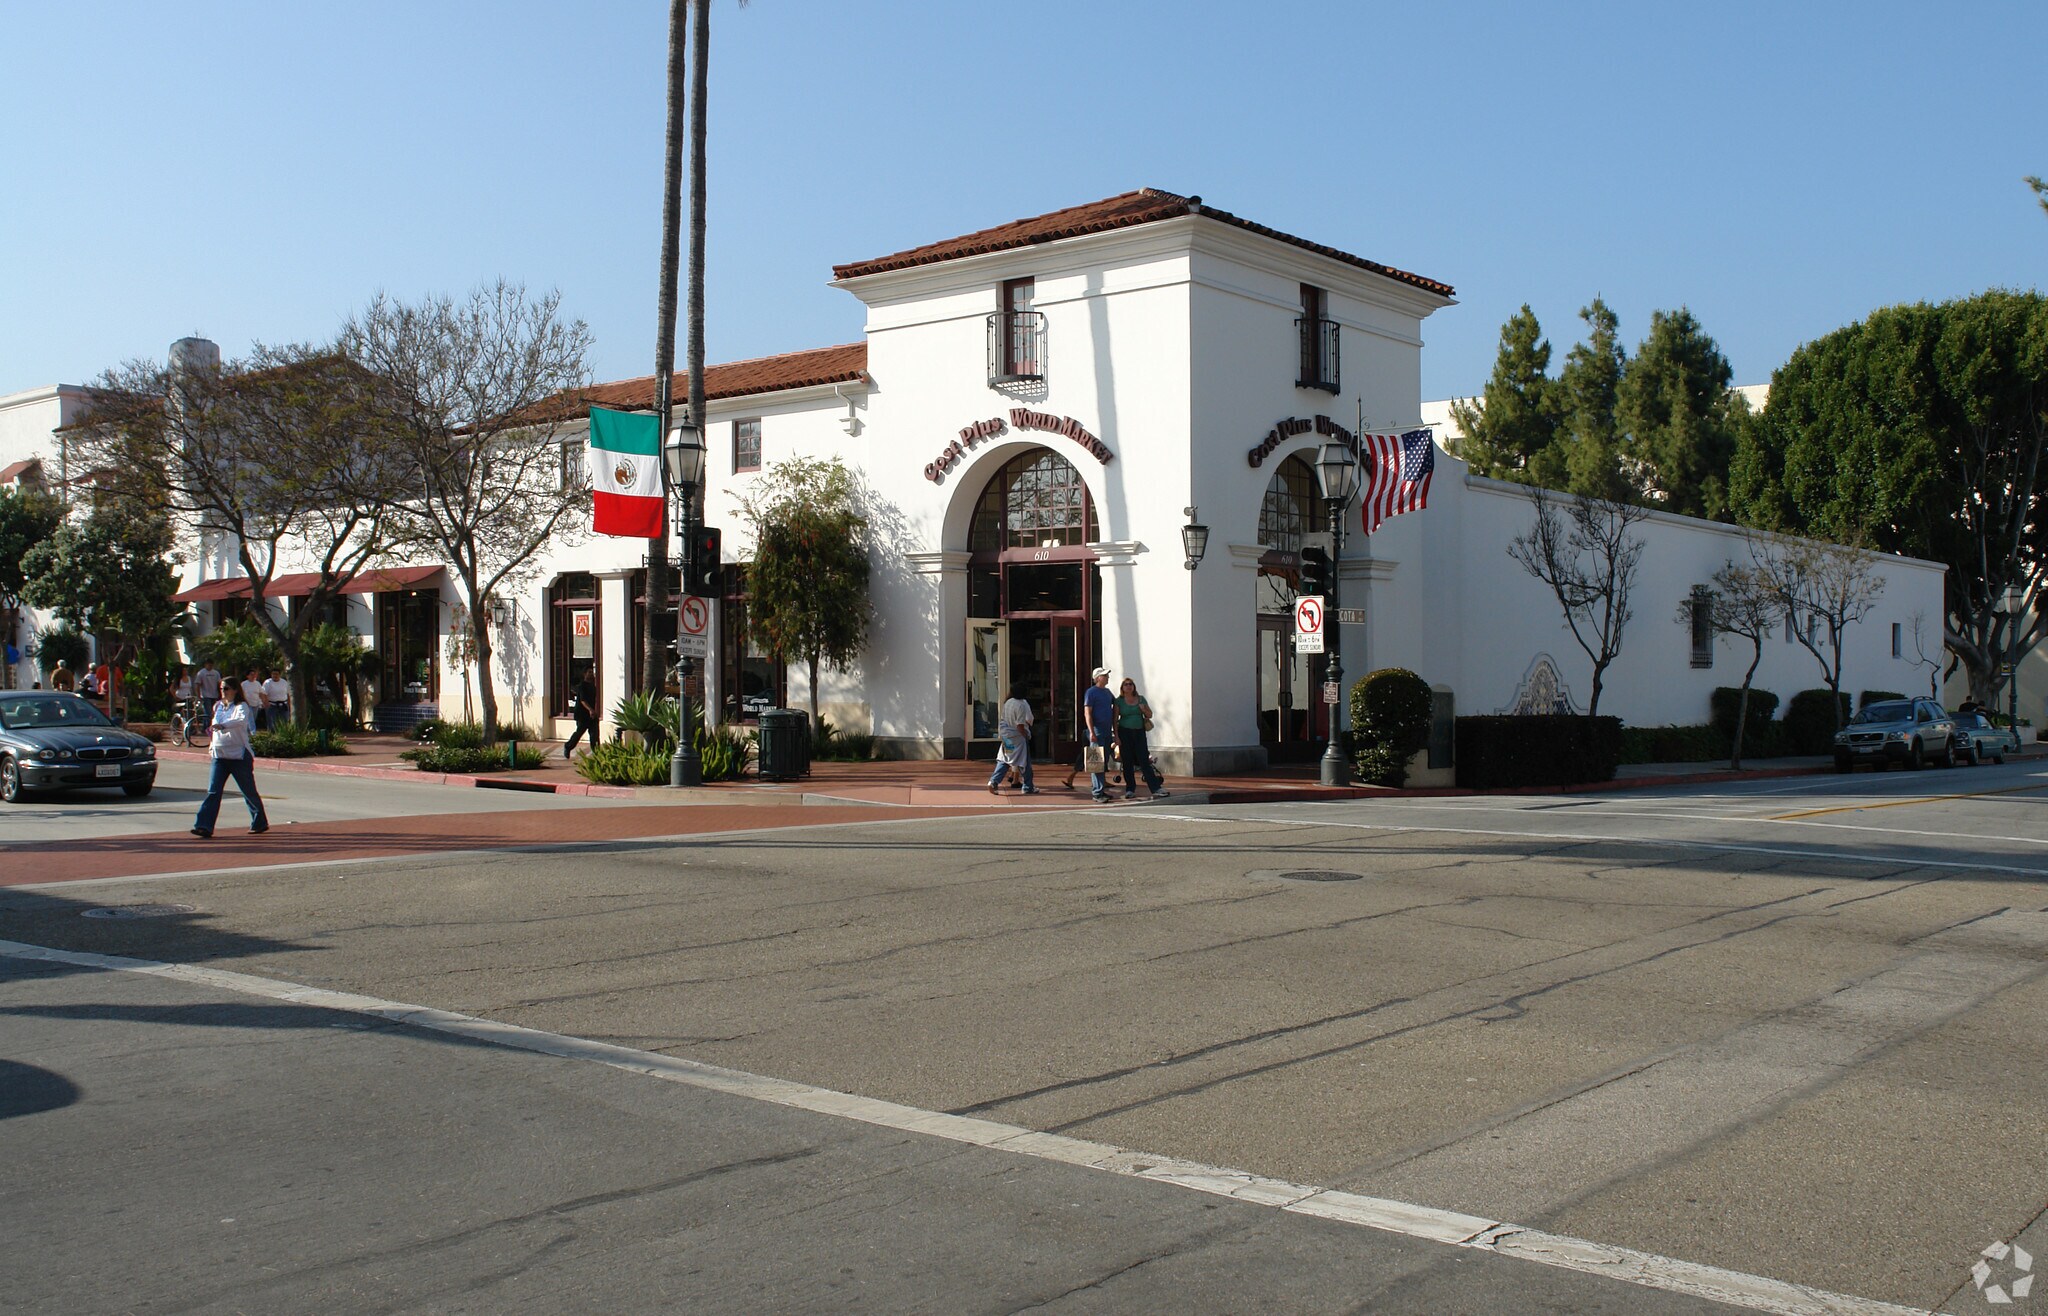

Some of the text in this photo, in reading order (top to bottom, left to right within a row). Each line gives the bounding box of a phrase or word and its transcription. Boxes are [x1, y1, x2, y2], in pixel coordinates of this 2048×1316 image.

[924, 440, 963, 482] Cost
[959, 417, 1002, 448] Plus
[1248, 429, 1281, 468] Cost
[1277, 416, 1312, 441] Plus
[1034, 550, 1049, 561] 610
[1340, 610, 1355, 621] COTA
